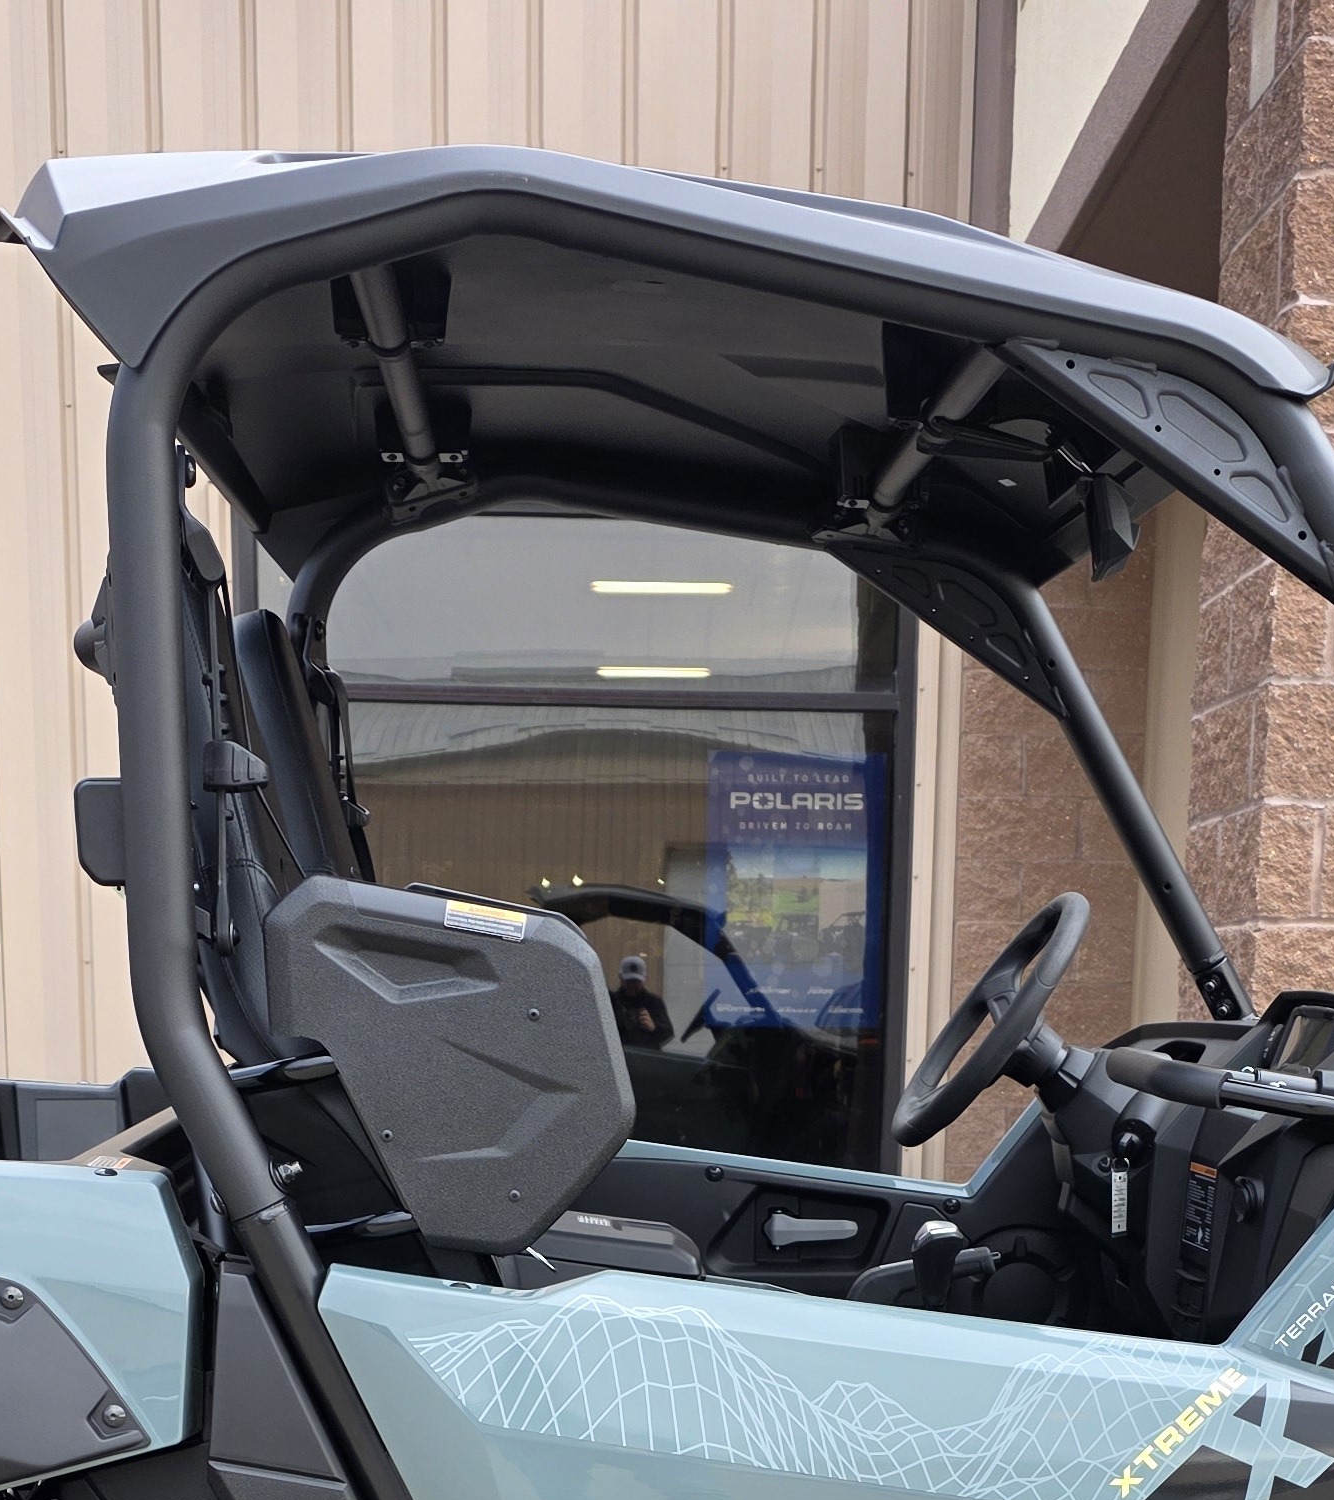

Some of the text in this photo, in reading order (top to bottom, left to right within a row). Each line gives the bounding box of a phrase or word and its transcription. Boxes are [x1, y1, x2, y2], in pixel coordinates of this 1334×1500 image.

[747, 774, 851, 783] BUILT TO LEAD
[729, 791, 865, 811] POLARIS
[739, 821, 852, 831] DRIVEN TO ROAM
[1109, 1367, 1249, 1499] XTREME
